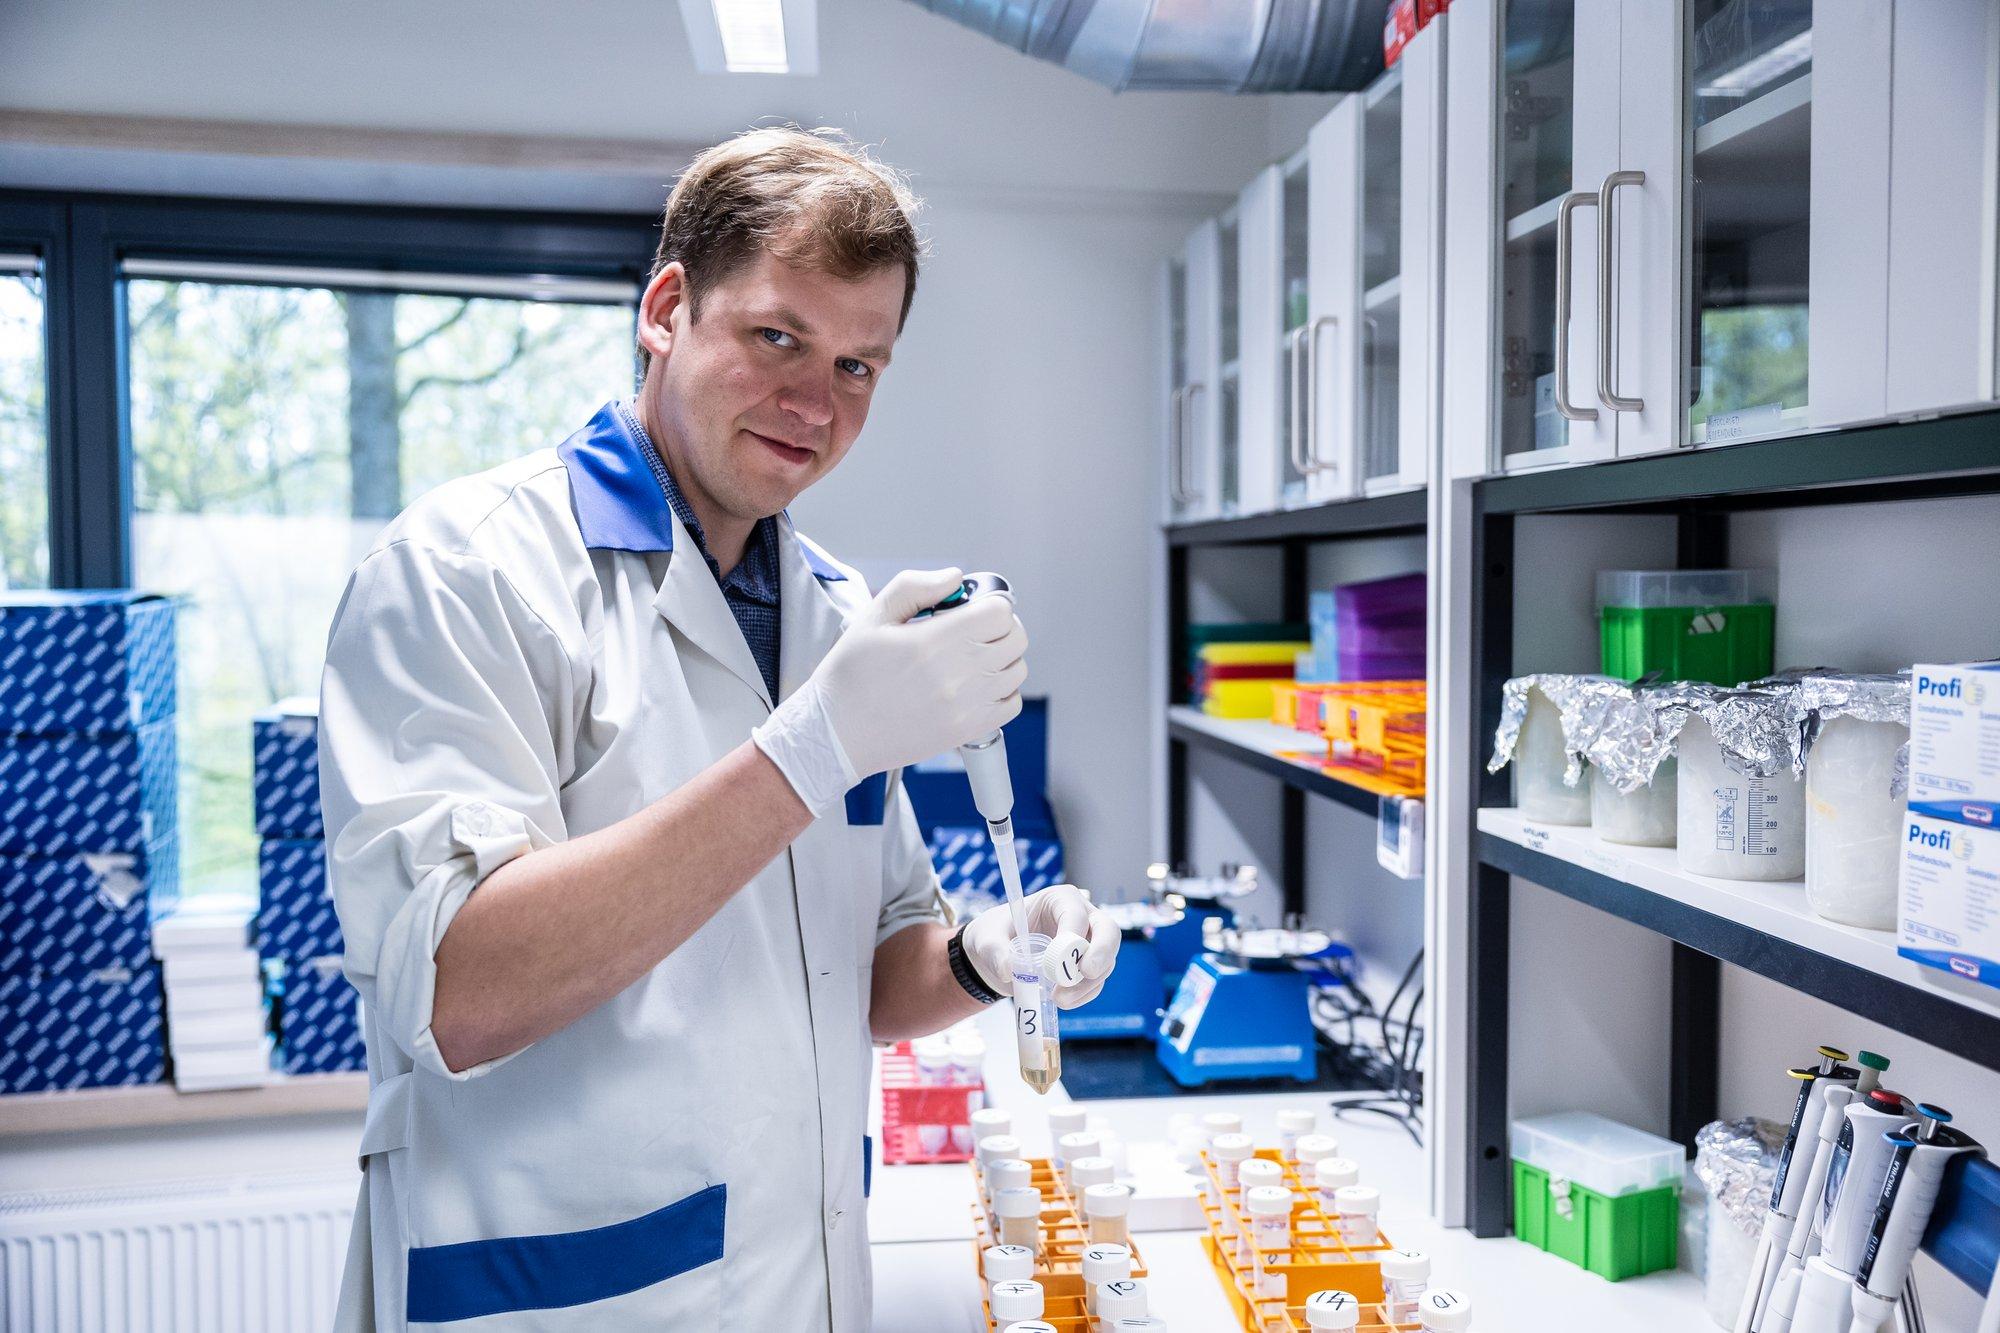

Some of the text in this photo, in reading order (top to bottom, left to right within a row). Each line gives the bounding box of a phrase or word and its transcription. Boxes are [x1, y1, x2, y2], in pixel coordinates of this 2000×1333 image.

[1918, 676, 1961, 698] Profi
[1909, 824, 1951, 850] Profi
[1062, 947, 1084, 981] 12
[1017, 1006, 1037, 1035] 13
[997, 1245, 1027, 1256] 13
[1315, 1291, 1357, 1311] 14
